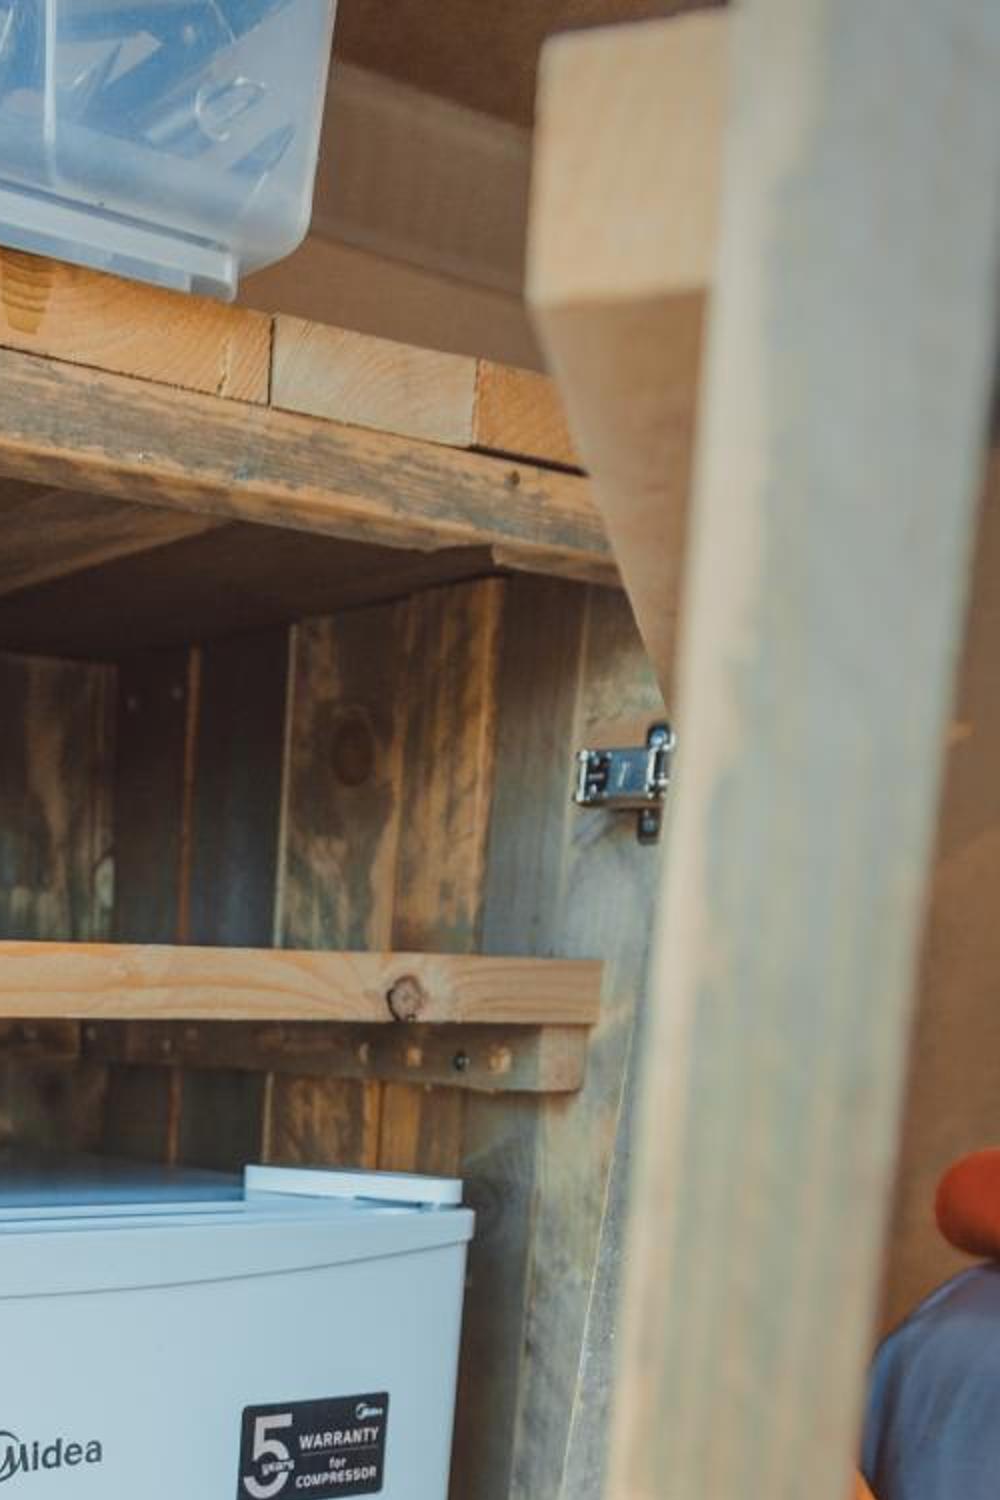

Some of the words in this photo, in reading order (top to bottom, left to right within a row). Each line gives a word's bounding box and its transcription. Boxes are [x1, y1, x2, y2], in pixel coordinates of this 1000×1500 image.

[299, 1426, 379, 1449] WARRANTY
[243, 1413, 293, 1500] 5
[328, 1456, 347, 1469] for
[295, 1465, 378, 1489] COMPRESSOR
